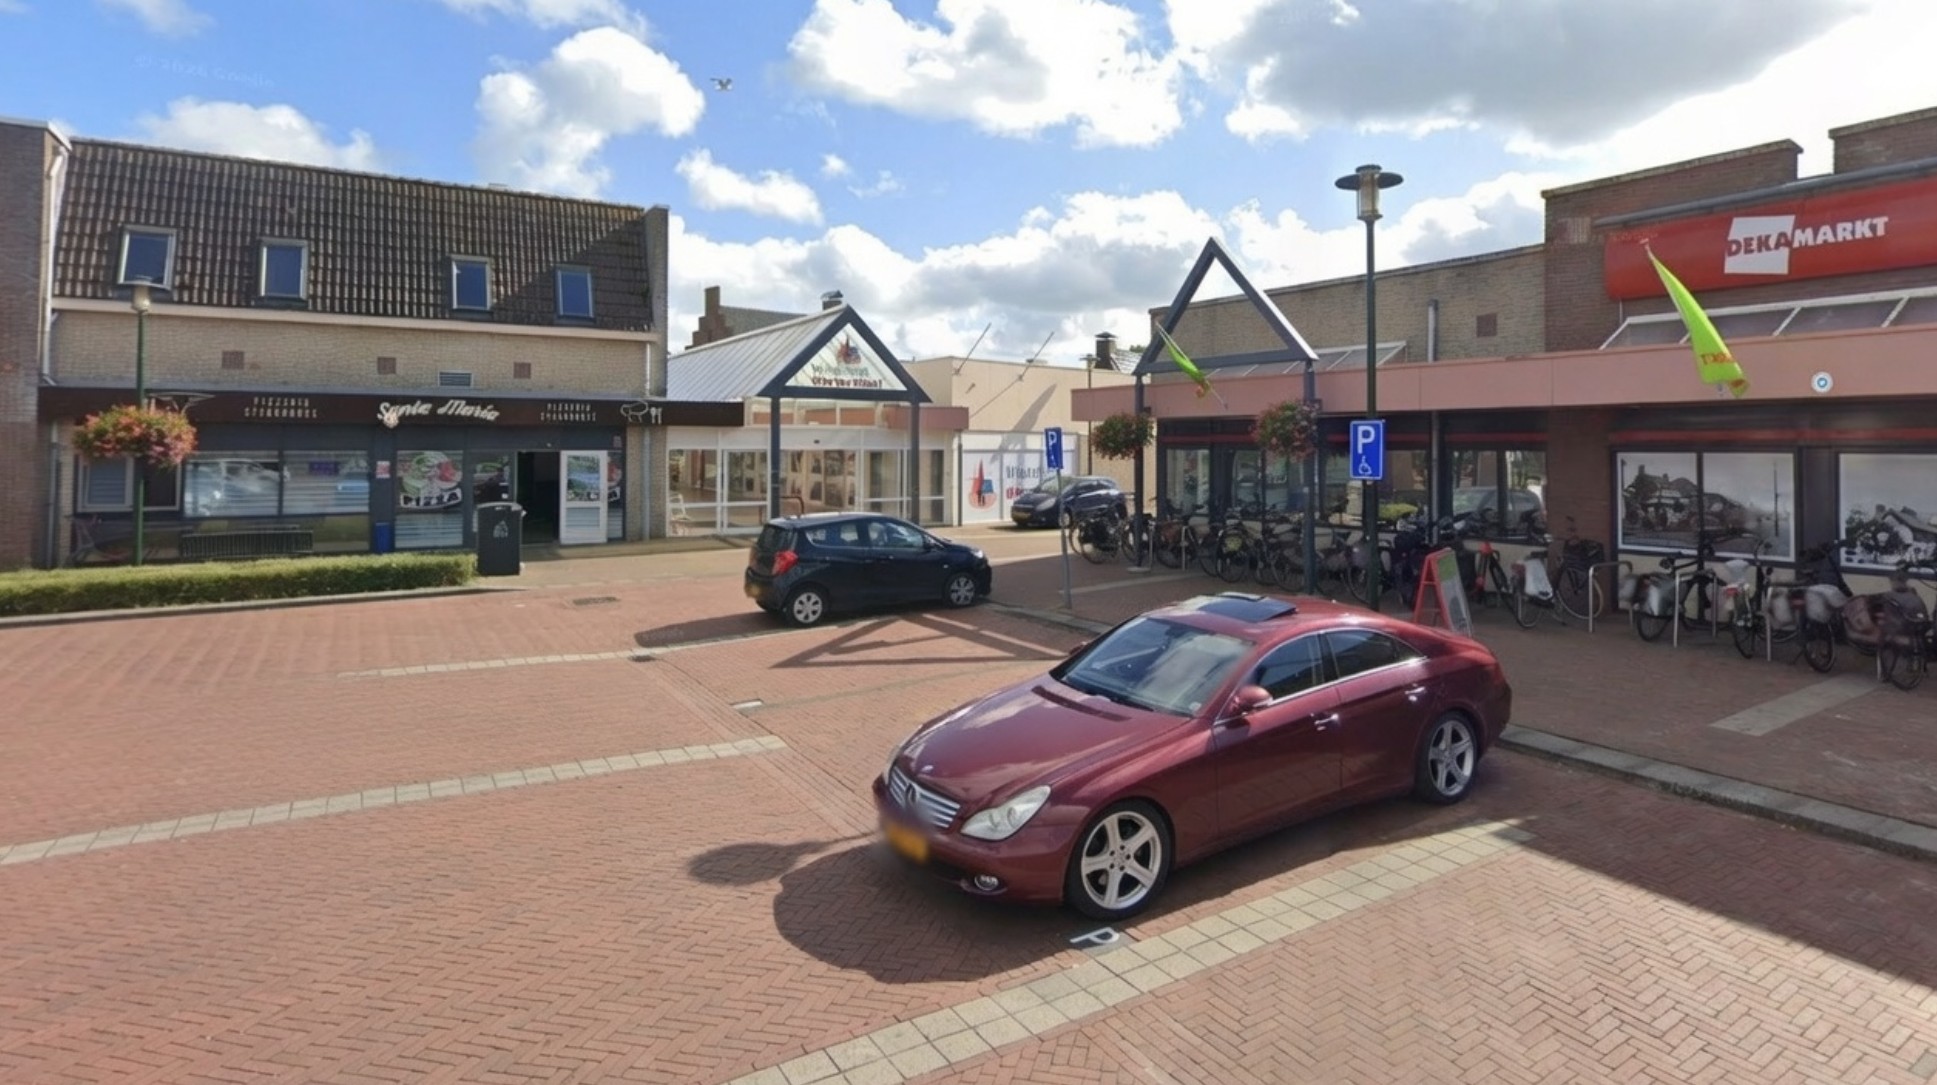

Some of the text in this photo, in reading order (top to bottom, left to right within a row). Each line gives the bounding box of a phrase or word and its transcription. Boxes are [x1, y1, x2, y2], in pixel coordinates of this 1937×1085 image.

[1727, 216, 1889, 257] DEKAMARKT
[1048, 431, 1058, 449] P
[1357, 425, 1376, 454] P
[1069, 927, 1119, 944] P
